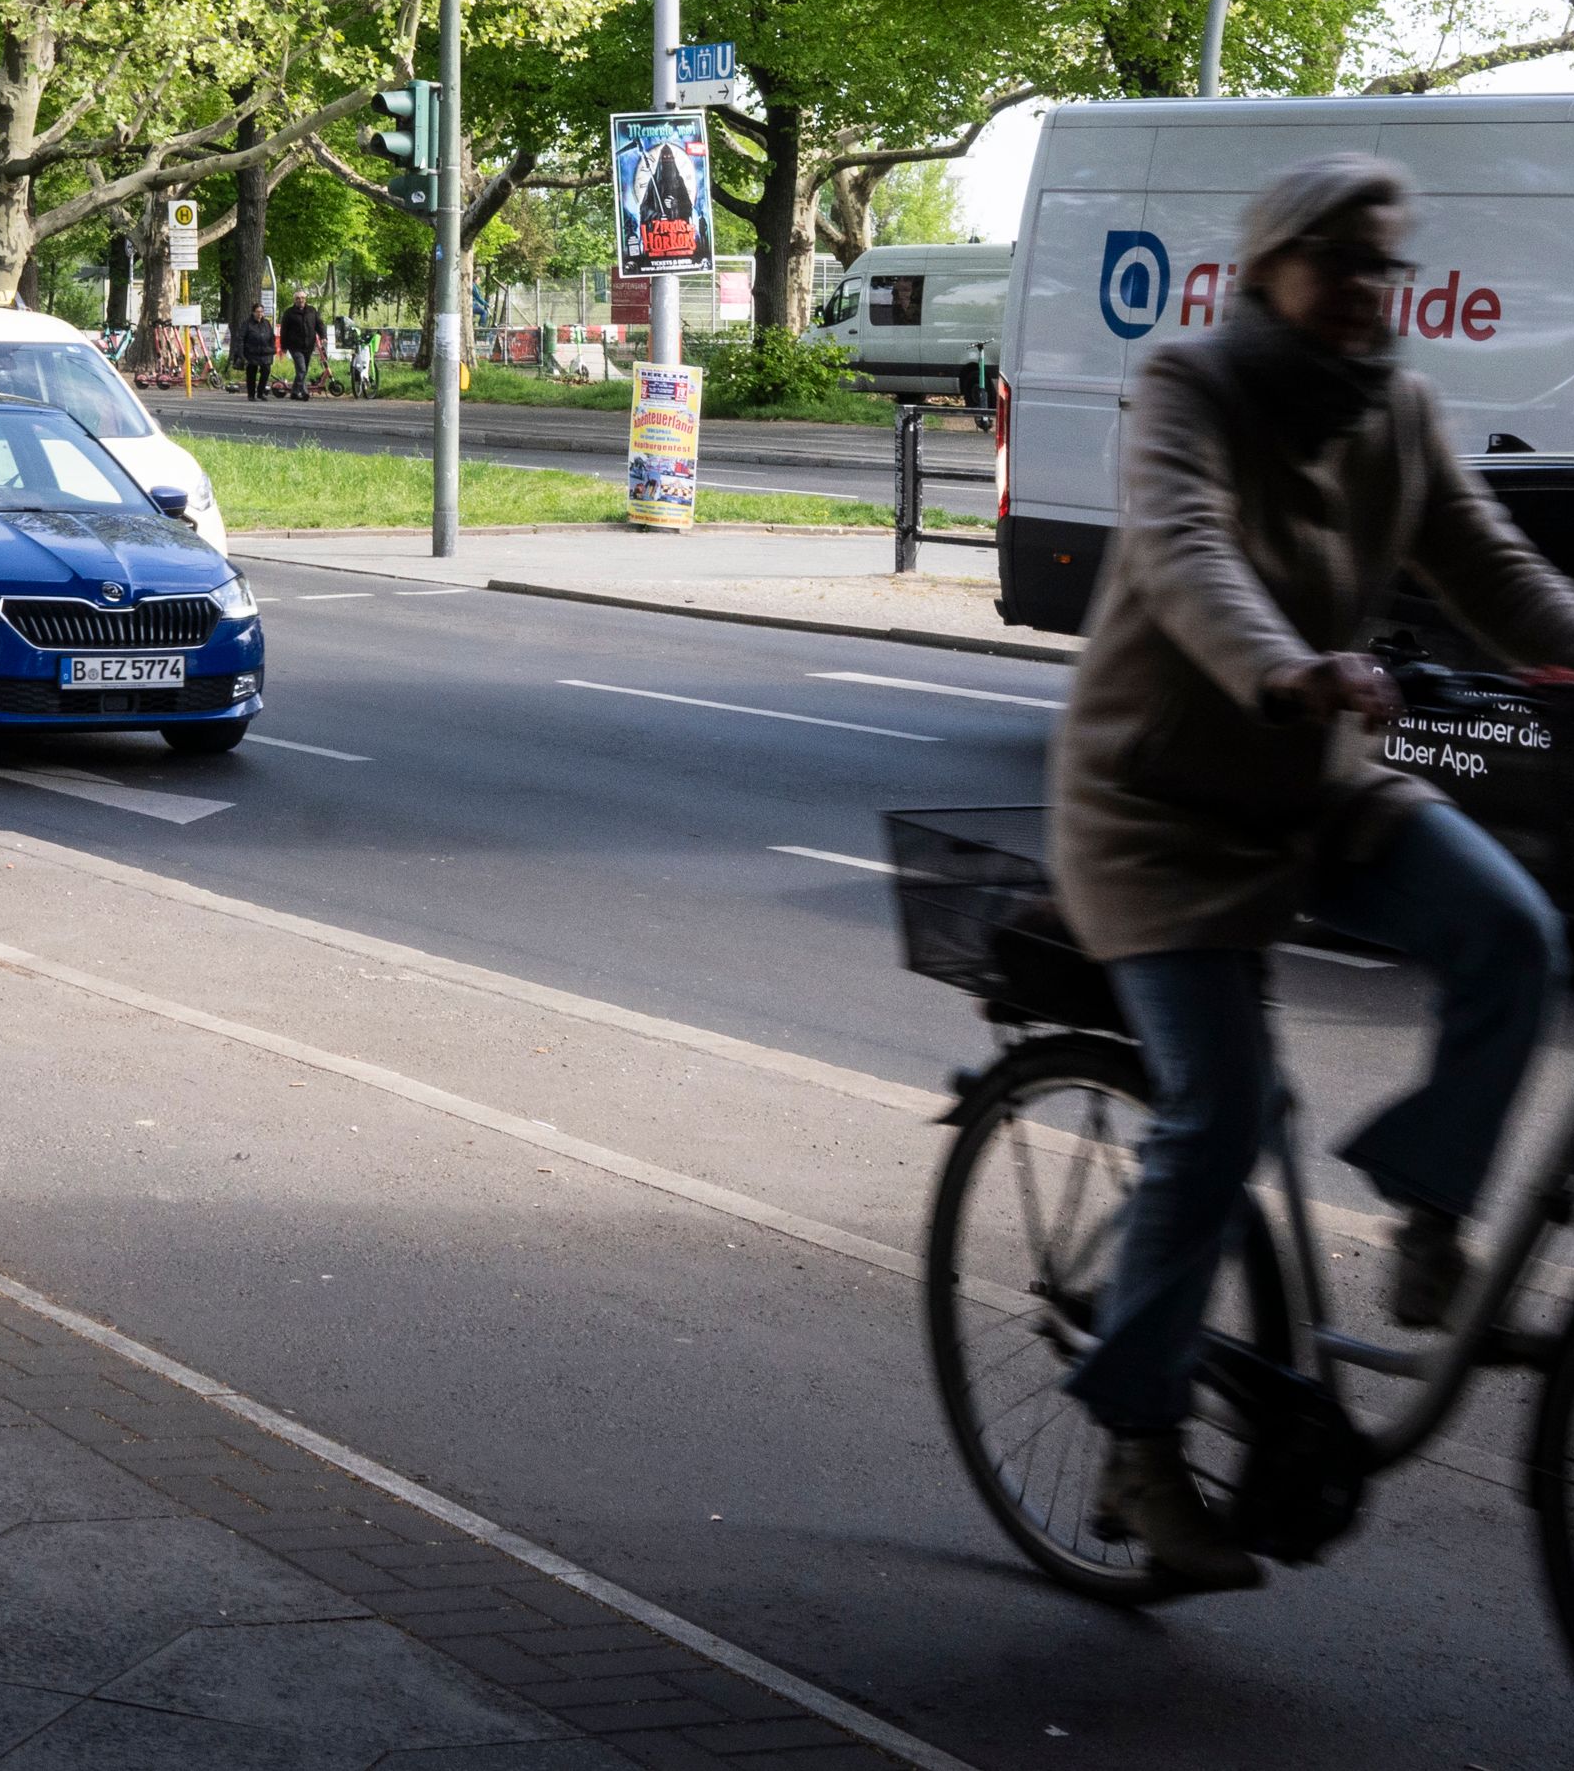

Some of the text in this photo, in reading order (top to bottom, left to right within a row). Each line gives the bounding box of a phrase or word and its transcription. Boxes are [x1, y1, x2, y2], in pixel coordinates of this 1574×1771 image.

[717, 44, 732, 78] U
[73, 660, 86, 682] B
[101, 659, 128, 681] EZ
[131, 658, 182, 680] 5774
[1467, 713, 1515, 744] über
[1518, 721, 1552, 749] die
[1384, 735, 1489, 779] Uber App.
